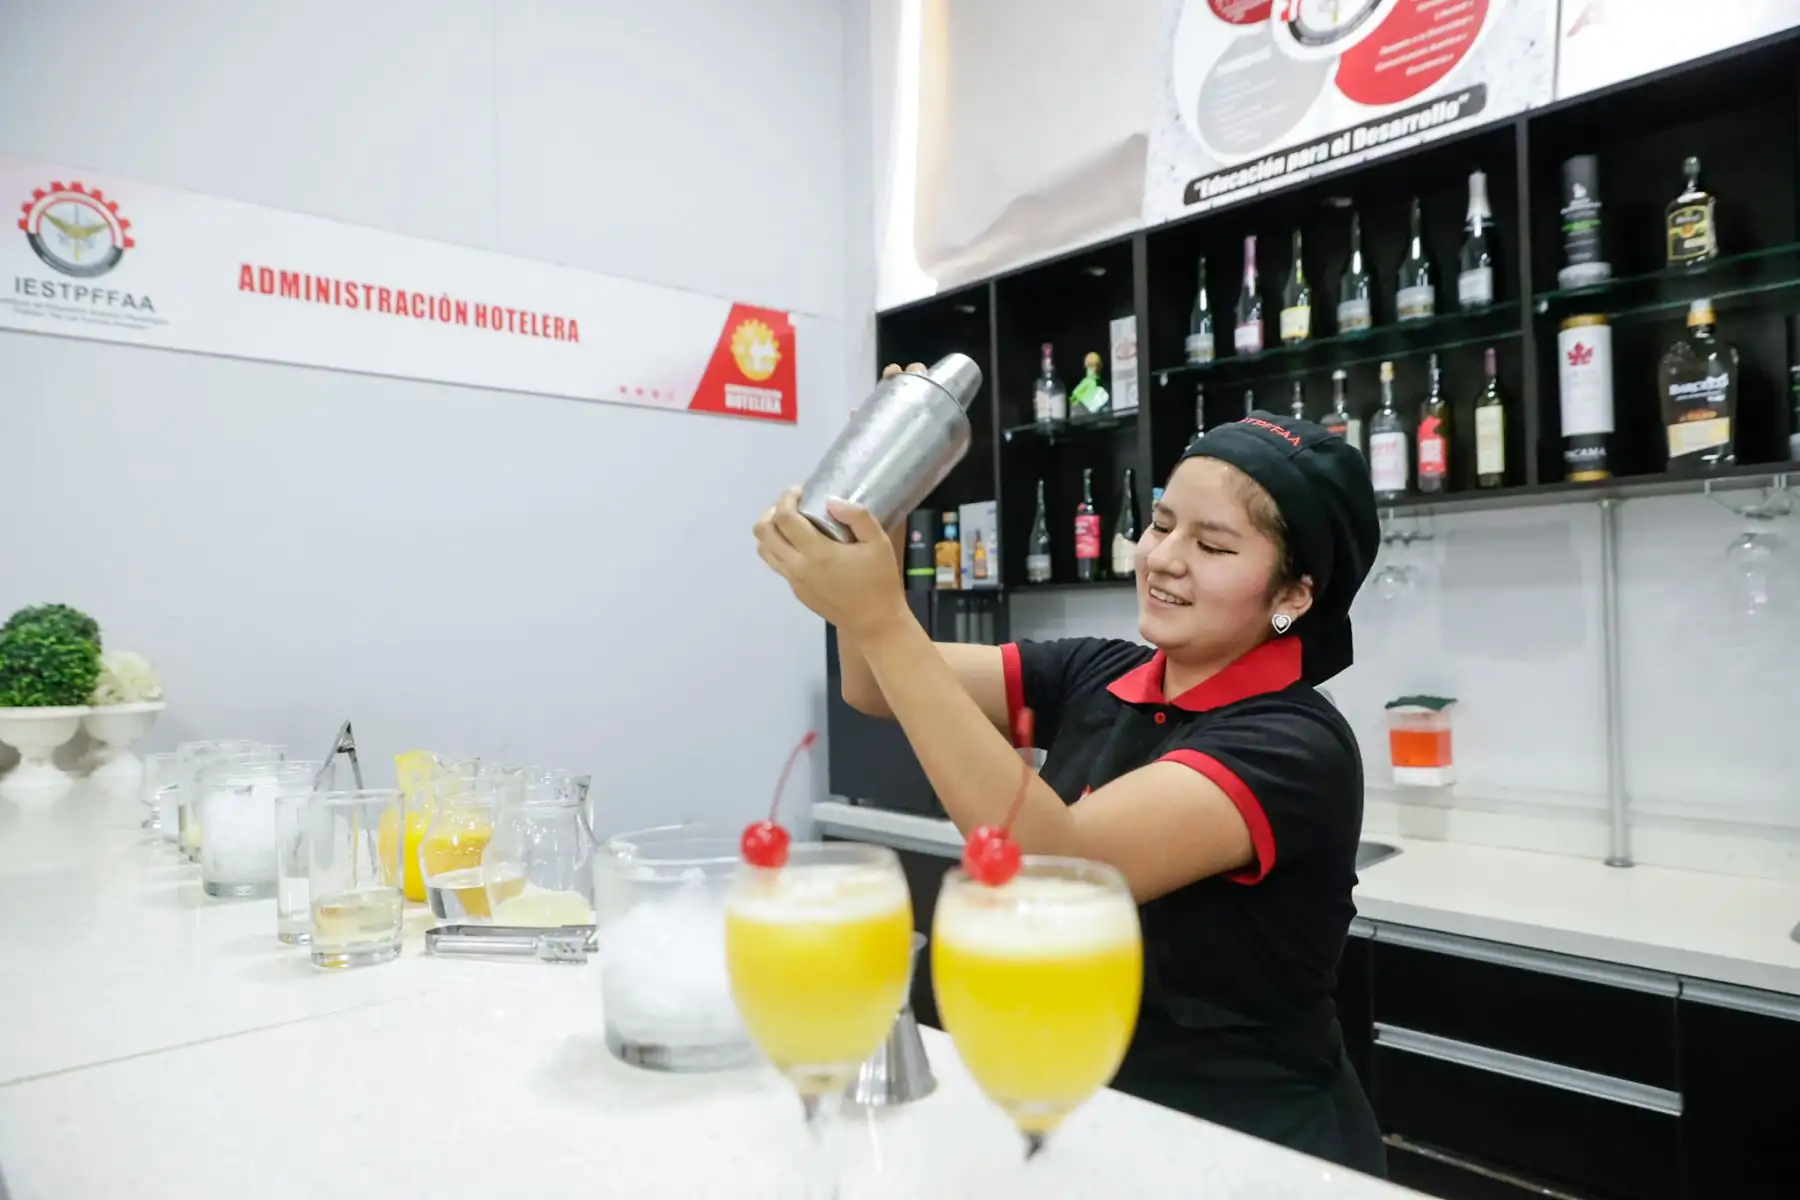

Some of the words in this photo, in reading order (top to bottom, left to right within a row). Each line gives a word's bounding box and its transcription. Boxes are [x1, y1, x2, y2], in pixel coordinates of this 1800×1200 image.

[1286, 141, 1329, 175] para
[1331, 133, 1350, 158] el
[14, 276, 155, 313] IESTPFFAA
[238, 262, 468, 326] ADMINISTRACIÓN
[475, 302, 580, 343] HOTELERA
